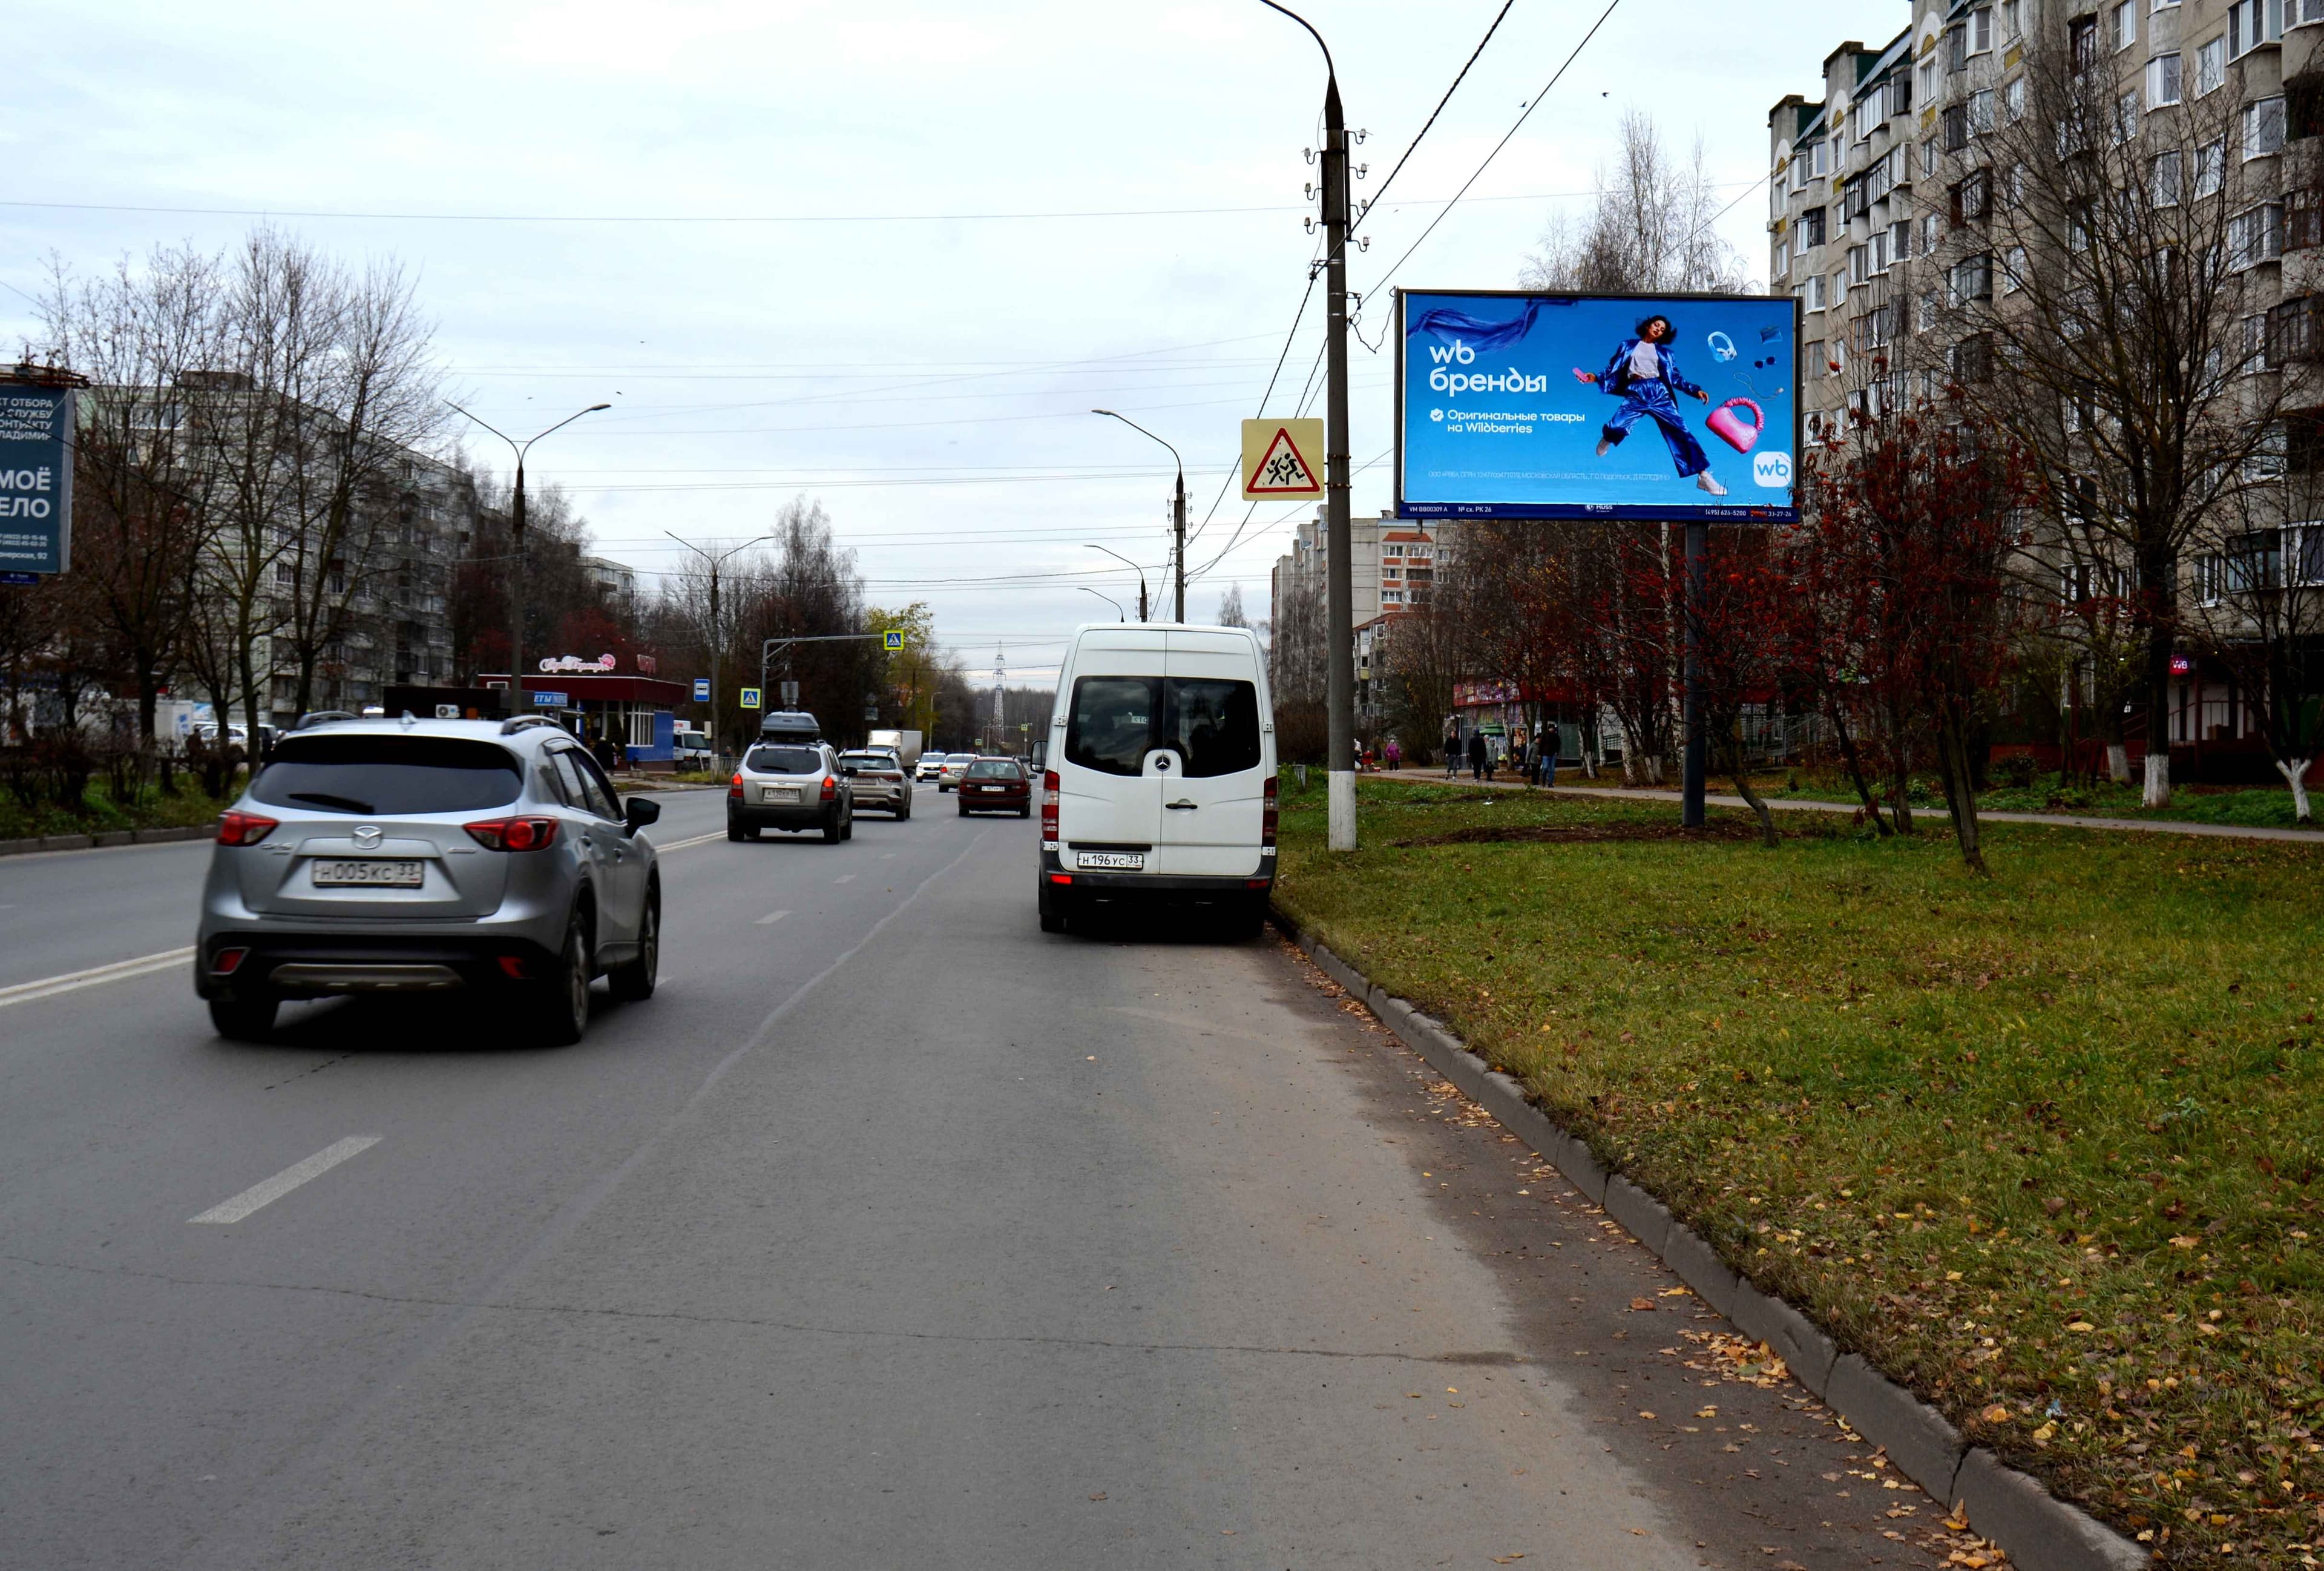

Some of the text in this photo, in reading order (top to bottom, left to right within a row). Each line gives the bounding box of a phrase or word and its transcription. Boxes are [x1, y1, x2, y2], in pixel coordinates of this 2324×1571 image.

[1429, 339, 1475, 364] wb
[1430, 366, 1547, 397] бренды
[10, 398, 53, 407] ОТБОРА
[7, 409, 53, 419] СЛУЖБУ
[1447, 409, 1585, 424] Оригинальные товары
[1447, 422, 1533, 433] на Wildberries
[1756, 459, 1789, 476] wb
[0, 466, 51, 491] МОЁ
[0, 497, 50, 519] ЕЛО
[1128, 855, 1139, 864] 33
